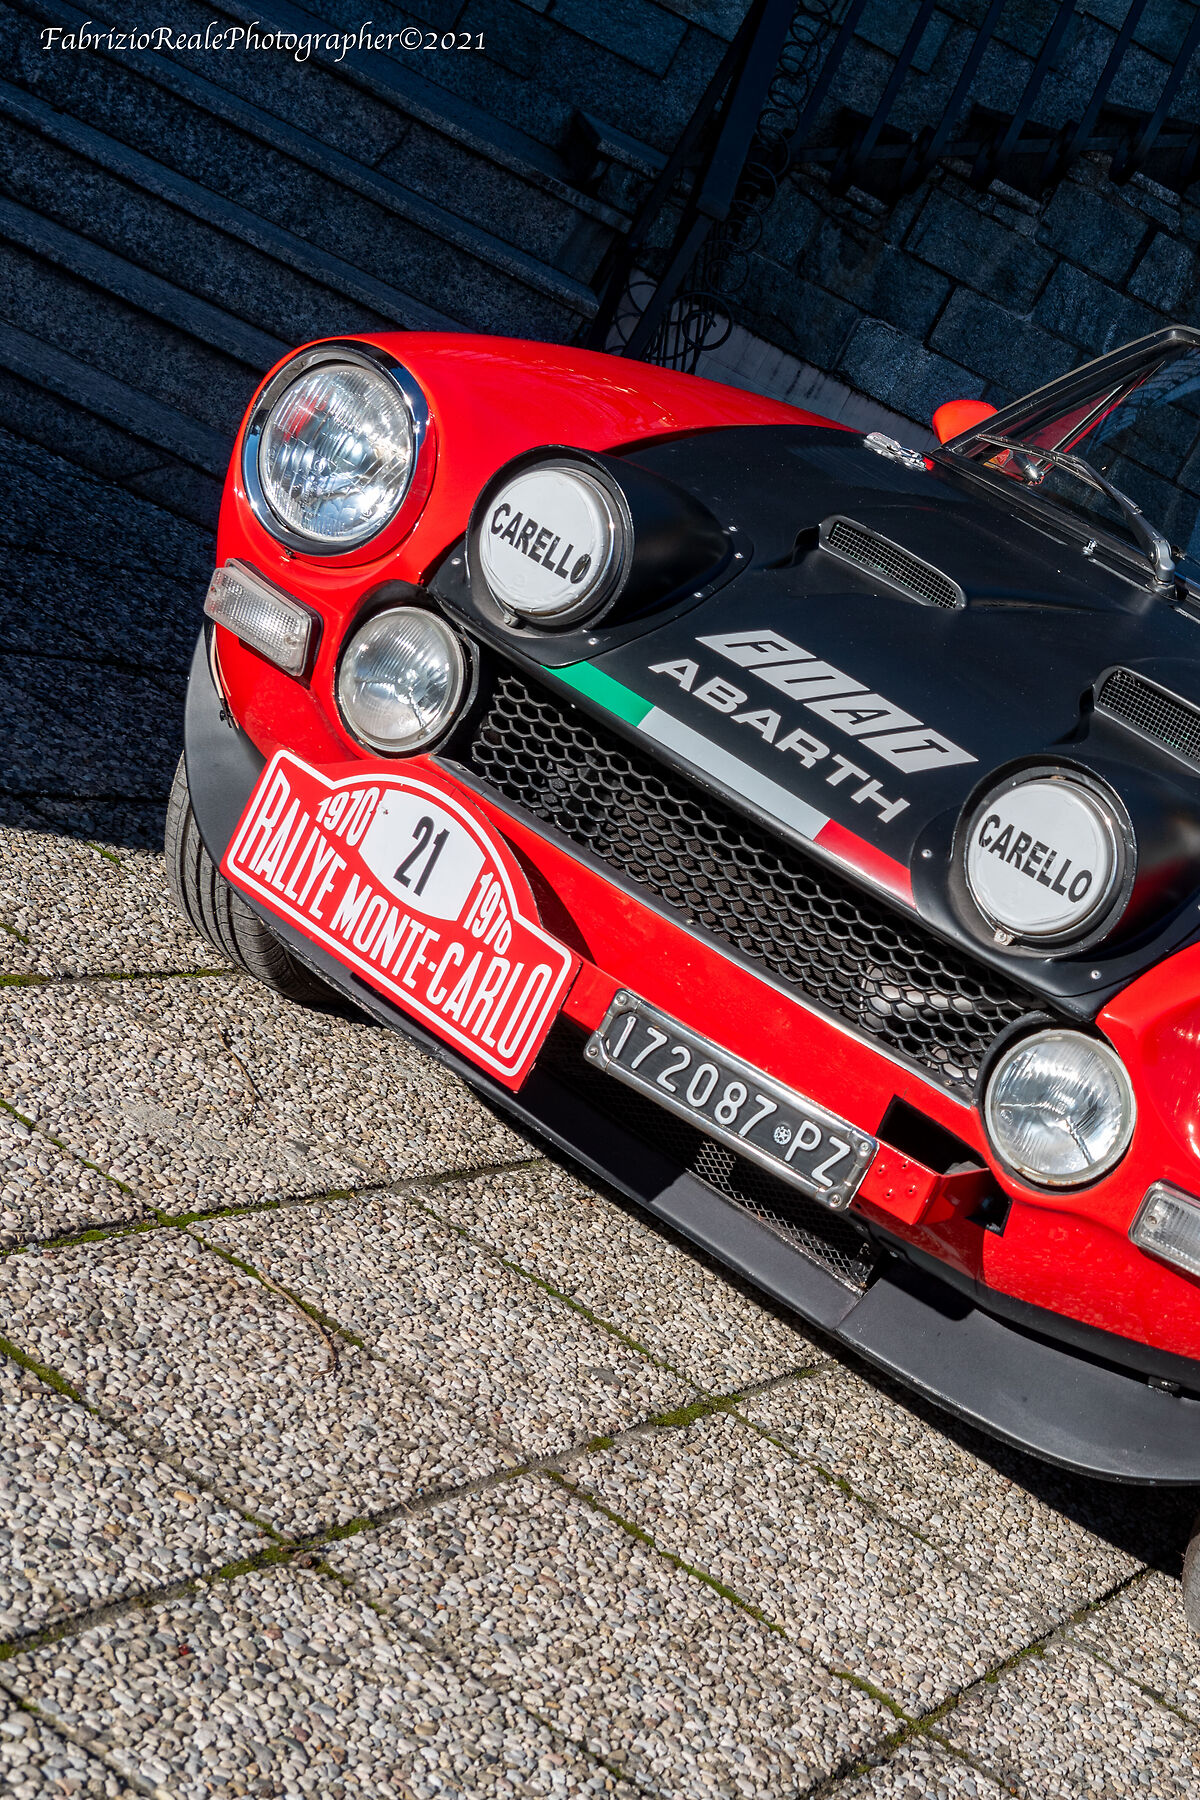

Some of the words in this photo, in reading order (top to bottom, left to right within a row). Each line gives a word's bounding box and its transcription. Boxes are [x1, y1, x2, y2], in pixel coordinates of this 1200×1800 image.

[490, 502, 592, 584] CARELLO
[648, 658, 911, 823] ABARTH
[696, 630, 978, 773] FIAT
[315, 787, 380, 847] 1970
[393, 816, 450, 897] 21
[978, 814, 1092, 903] CARELLO
[238, 768, 347, 921] RALLYE
[329, 873, 553, 1059] MONTE-CARLO
[462, 872, 513, 956] 1970
[612, 1015, 778, 1137] 172087
[784, 1120, 851, 1188] PZ
